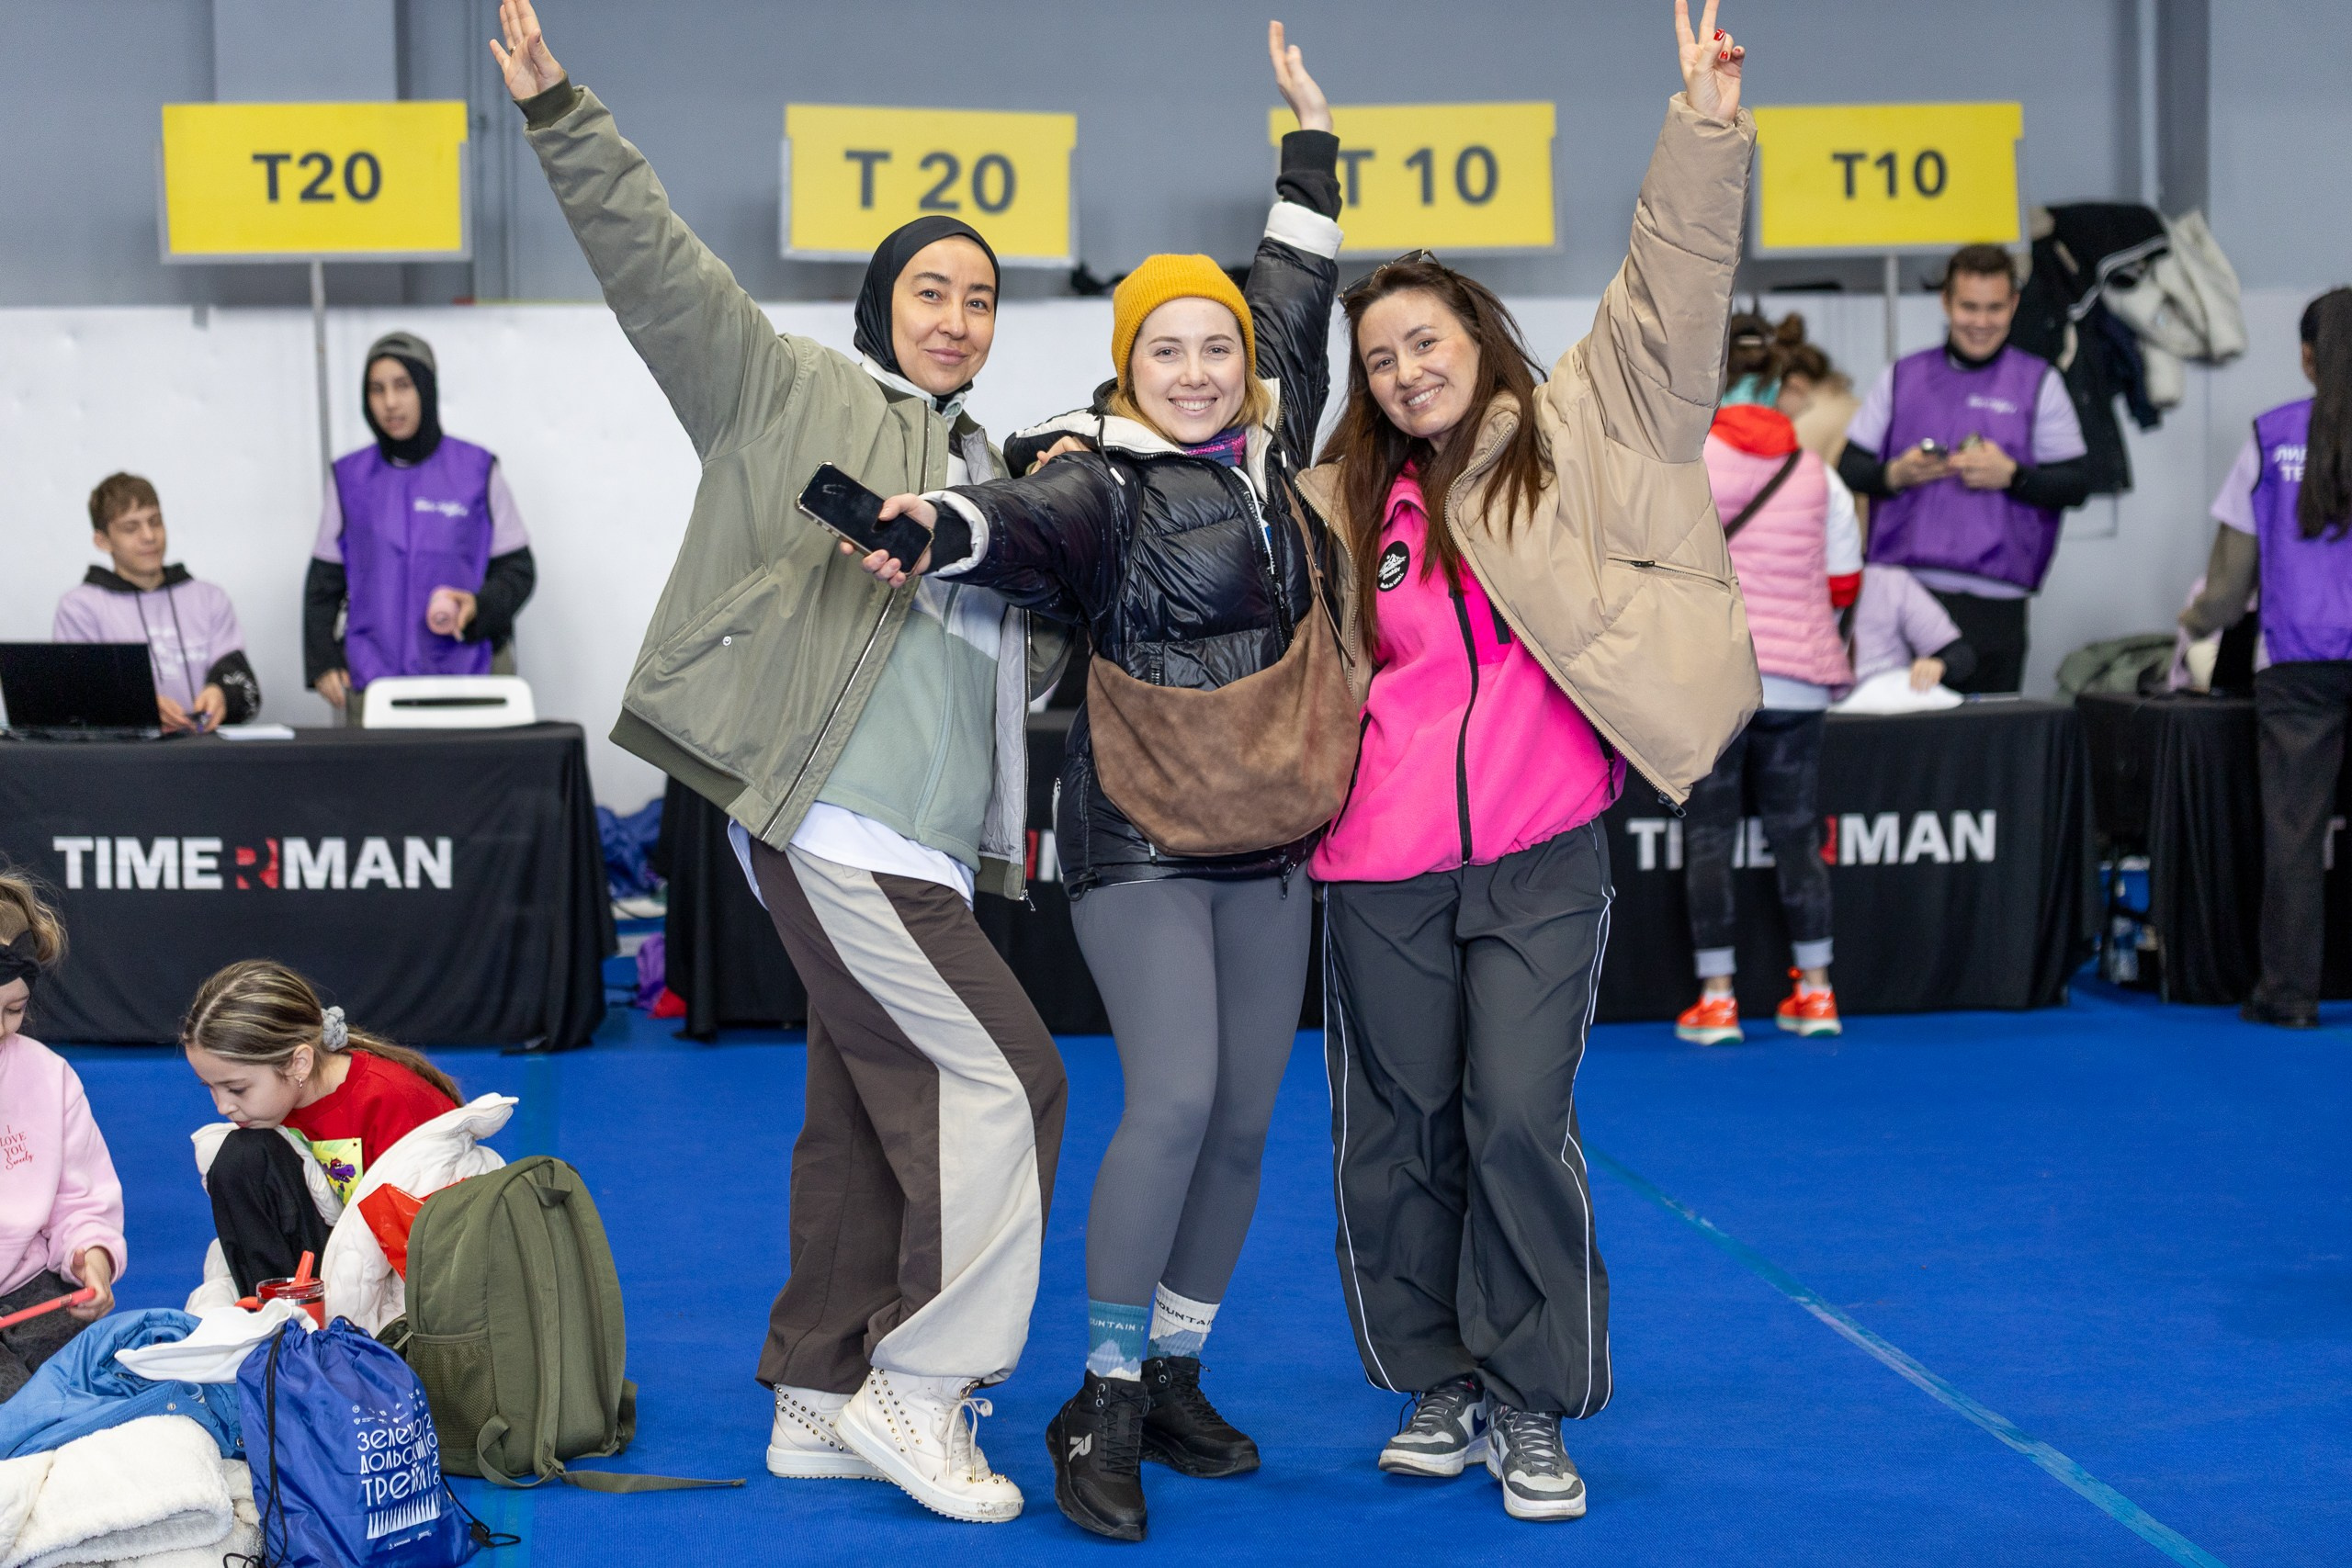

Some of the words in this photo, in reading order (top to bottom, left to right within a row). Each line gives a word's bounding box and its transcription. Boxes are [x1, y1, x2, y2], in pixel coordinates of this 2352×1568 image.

[252, 151, 383, 202] T20
[844, 150, 891, 209] T
[918, 152, 1017, 213] 20
[1338, 148, 1375, 208] T
[1404, 144, 1499, 207] 10
[1831, 149, 1949, 198] T10
[1626, 809, 1996, 871] TIEMAN
[0, 1131, 27, 1147] LOVE
[5, 1142, 27, 1158] YOU
